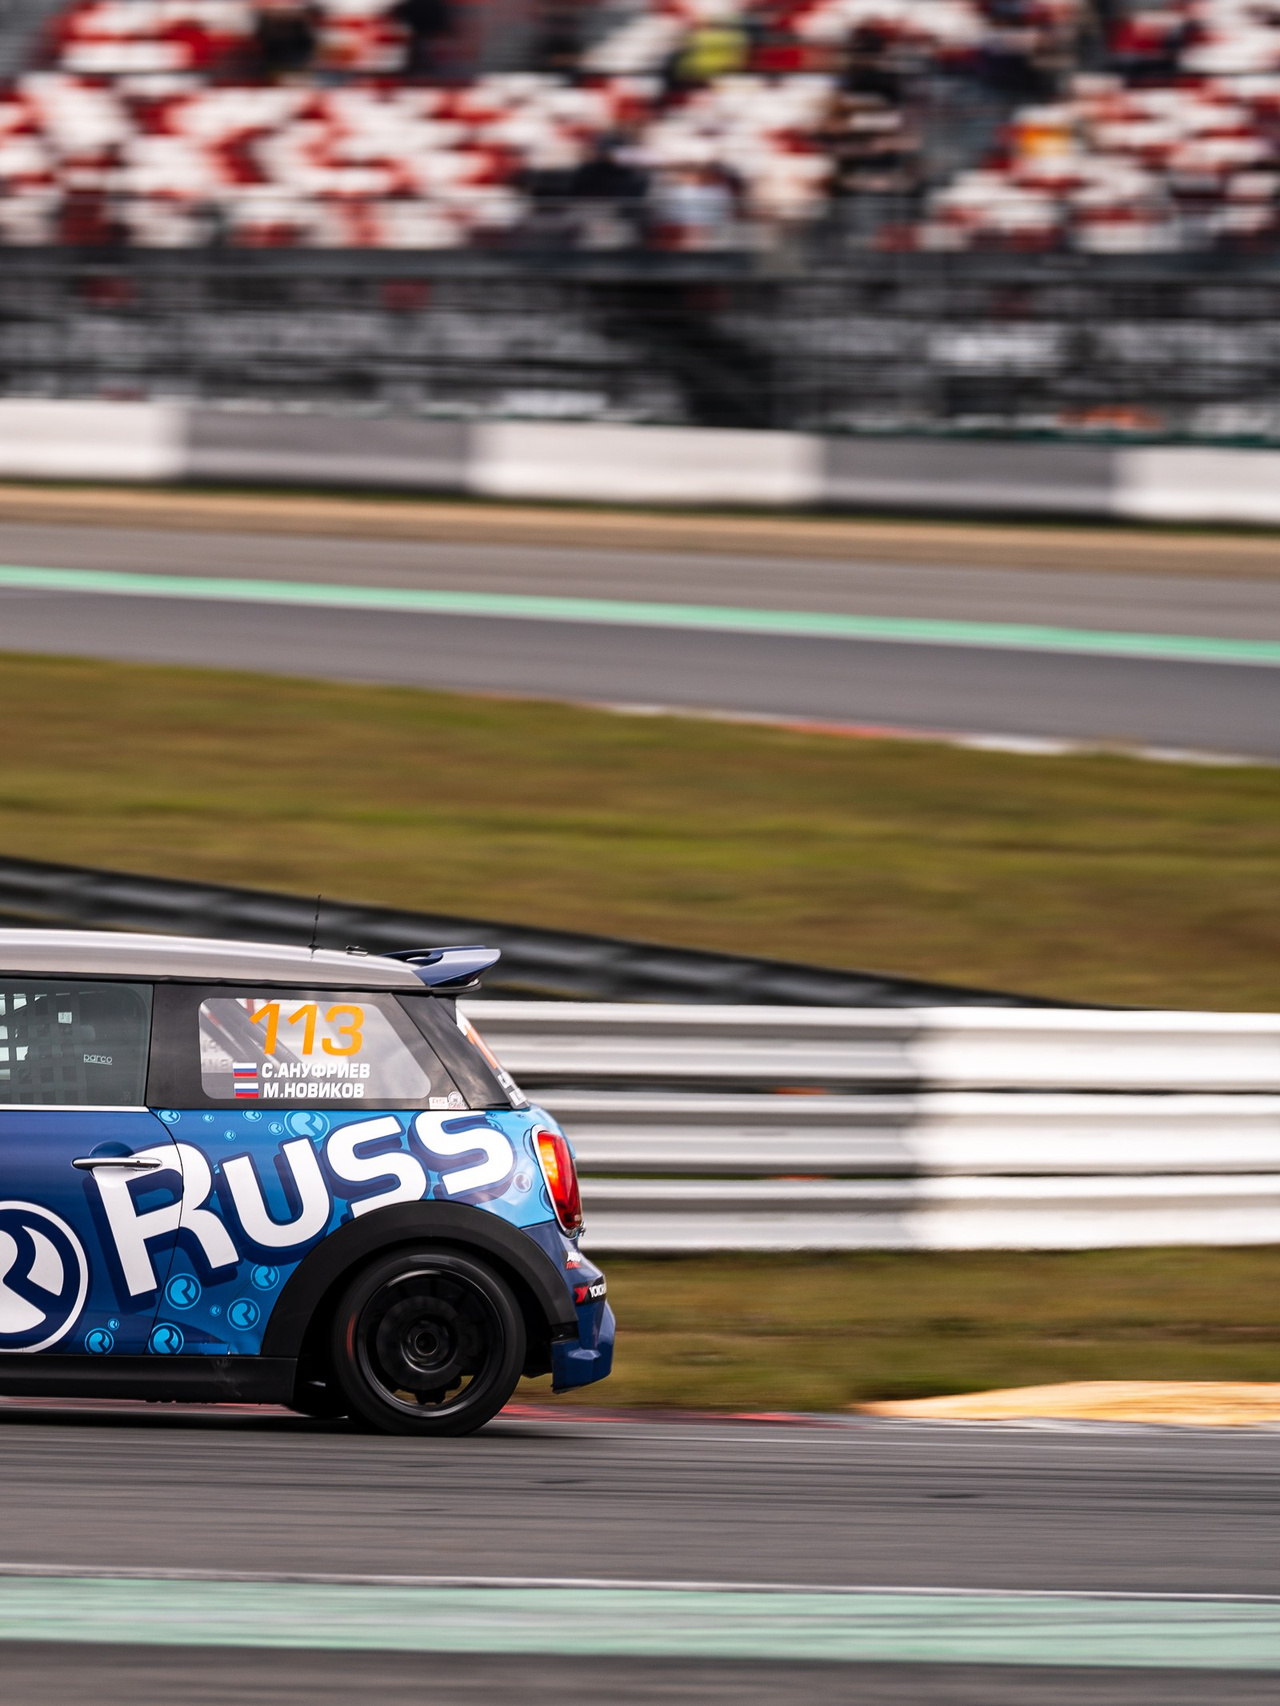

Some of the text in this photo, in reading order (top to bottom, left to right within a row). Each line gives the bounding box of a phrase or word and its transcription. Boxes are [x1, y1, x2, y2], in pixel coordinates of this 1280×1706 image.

[249, 1003, 365, 1057] 113
[261, 1062, 371, 1079] С.АНУФРИЕВ
[263, 1082, 365, 1098] М.НОВИКОВ
